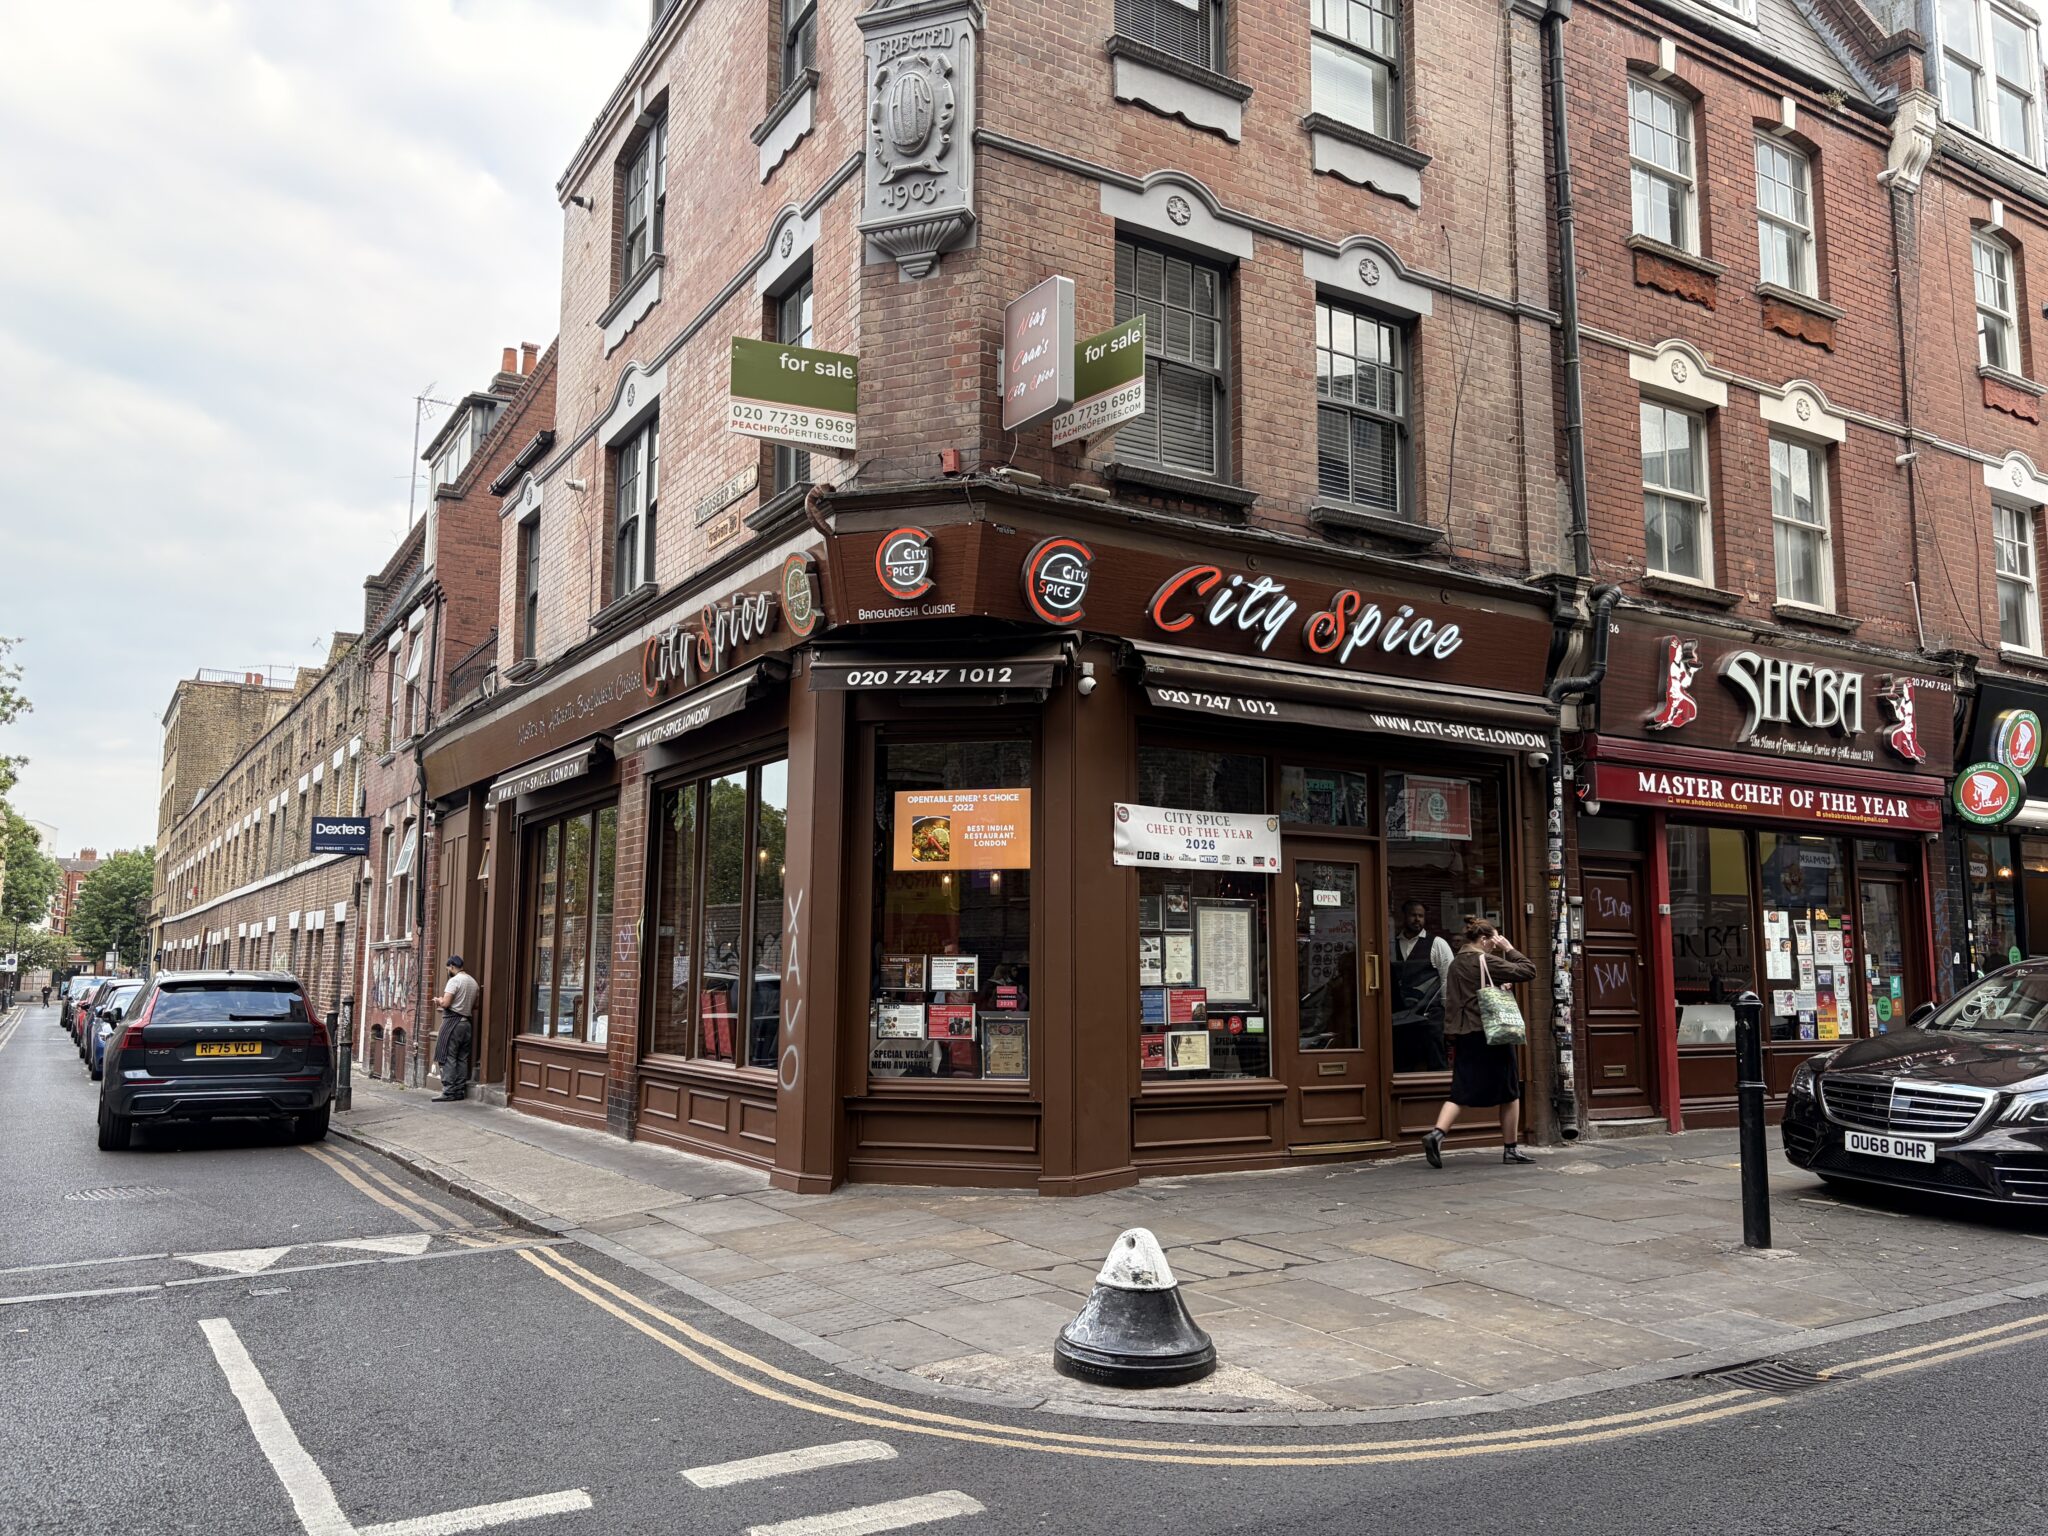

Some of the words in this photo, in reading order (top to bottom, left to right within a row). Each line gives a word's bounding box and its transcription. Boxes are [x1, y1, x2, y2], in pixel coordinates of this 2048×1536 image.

[877, 26, 953, 67] ERECTED
[1017, 307, 1047, 338] Niaz
[1085, 344, 1107, 364] for
[1111, 328, 1141, 353] sale
[779, 352, 809, 372] for
[814, 361, 853, 379] sale
[1007, 382, 1027, 402] City
[1030, 367, 1054, 391] Spice
[1054, 413, 1074, 431] 020
[1078, 400, 1107, 424] 7739
[1112, 387, 1141, 408] 6969
[733, 405, 763, 420] 020
[769, 411, 809, 427] 7739
[815, 418, 854, 434] 6969
[695, 487, 730, 522] WOODSEER
[903, 548, 927, 560] CITY
[886, 564, 915, 578] SPICE
[1062, 565, 1088, 582] CITY
[1038, 579, 1071, 599] SPICE
[858, 605, 919, 620] BANGLADESHI
[1153, 565, 1297, 652] City
[1306, 590, 1463, 665] Spice
[1609, 623, 1620, 634] 36
[642, 623, 696, 699] City
[698, 591, 778, 674] Spice
[846, 670, 888, 686] 020
[893, 669, 951, 684] 7247
[959, 667, 1013, 683] 1012
[1919, 679, 1936, 689] 7247
[1158, 688, 1191, 705] 020
[1194, 692, 1231, 711] 7247
[1238, 697, 1278, 716] 1012
[1726, 650, 1865, 738] SHEBA
[636, 705, 711, 749] WWW.CITY-SPICE.LONDON
[1369, 713, 1547, 749] WWW.CITY-SPICE.LONDON
[498, 761, 580, 800] WWW.CITY-SPICE.LONDON
[907, 795, 953, 804] OPENTABLE
[988, 793, 1020, 802] CHOICE
[1638, 772, 1725, 801] MASTER
[1730, 782, 1783, 806] CHEF
[1789, 789, 1815, 809] OF
[1819, 791, 1857, 814] THE
[1861, 796, 1910, 818] YEAR
[951, 804, 974, 812] 2022
[1164, 811, 1193, 824] CITY
[1196, 813, 1231, 827] SPICE
[315, 823, 366, 835] Dexters
[1146, 823, 1175, 835] CHEF
[1178, 825, 1193, 837] OF
[1197, 827, 1220, 838] THE
[1223, 829, 1254, 840] YEAR
[973, 839, 1007, 847] LONDON
[1185, 838, 1216, 850] 2026
[1136, 851, 1160, 861] BBC
[1316, 894, 1333, 903] OPEN
[1726, 960, 1750, 973] Lane
[234, 1042, 256, 1053] VCO
[873, 1049, 904, 1059] SPECIAL
[905, 1050, 929, 1059] VEGAN
[871, 1061, 892, 1070] MENU
[1851, 1134, 1890, 1154] OU68
[1894, 1140, 1927, 1160] OHR
